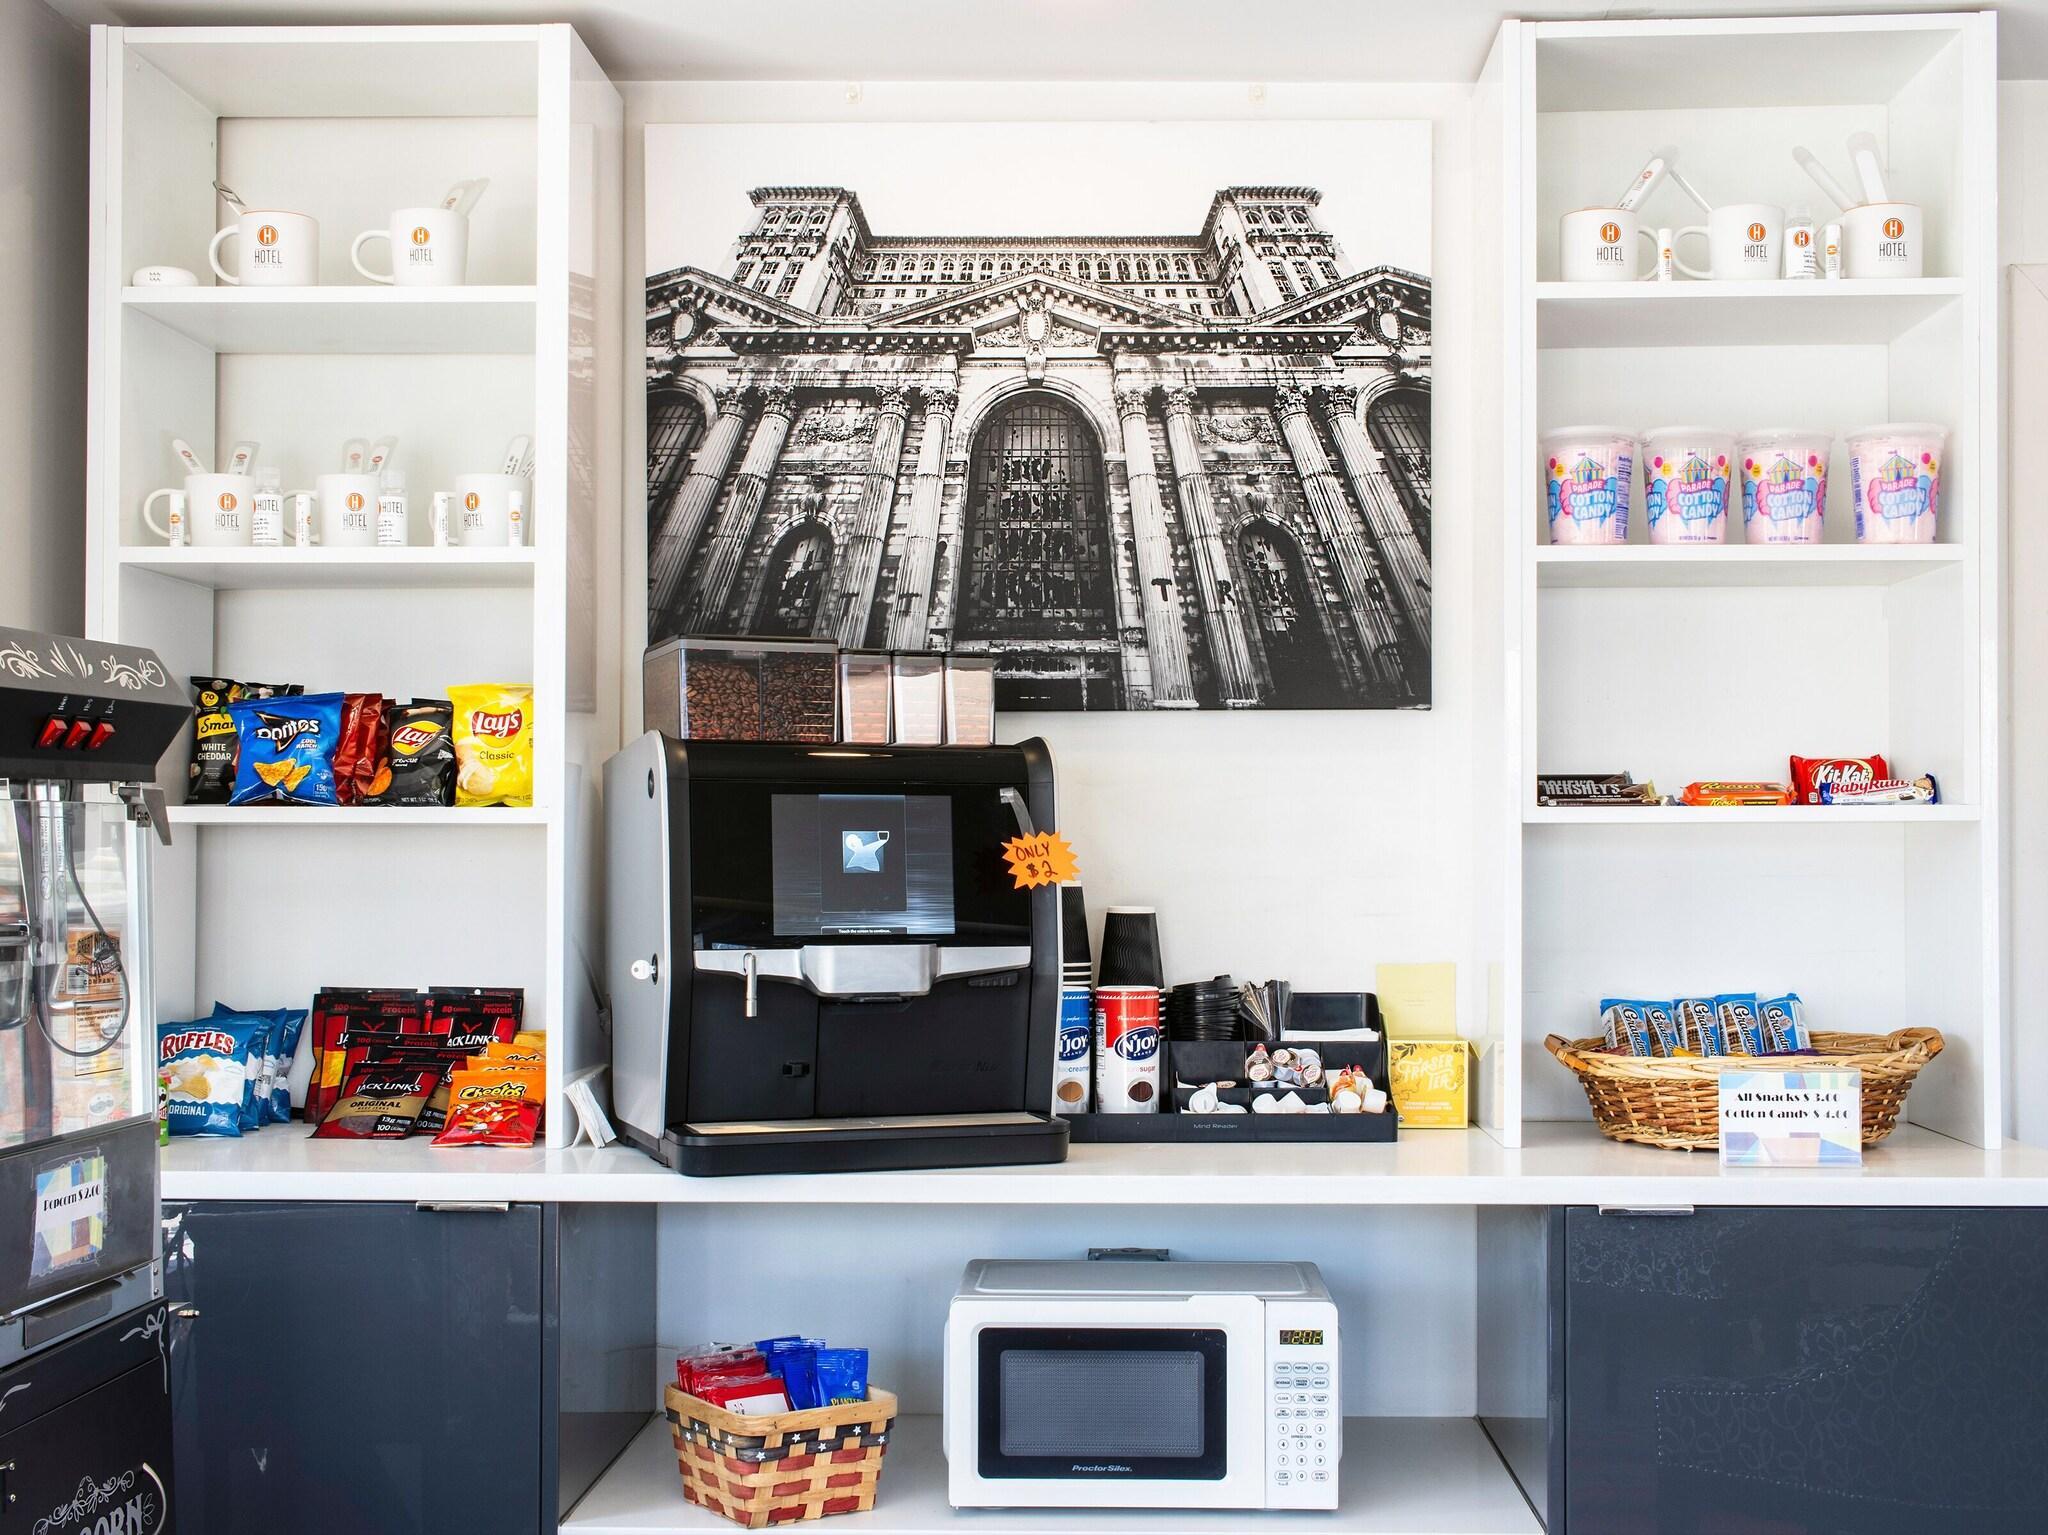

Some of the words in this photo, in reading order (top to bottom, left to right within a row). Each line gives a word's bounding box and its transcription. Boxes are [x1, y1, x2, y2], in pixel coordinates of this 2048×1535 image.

[410, 249, 432, 261] HOTEL
[1596, 247, 1623, 261] HOTEL
[1744, 245, 1768, 258] HOTEL
[1879, 243, 1907, 256] HOTEL
[255, 250, 283, 263] HOTEL
[1572, 481, 1603, 492] PARADE
[1681, 481, 1711, 492] PARADE
[1770, 482, 1801, 493] PARADE
[1883, 478, 1914, 490] PARADE
[1569, 492, 1615, 505] COTTON
[1678, 492, 1720, 505] COTTON
[1767, 491, 1812, 505] COTTON
[1879, 488, 1924, 503] COTTON
[257, 500, 279, 511] HOTEL
[382, 502, 403, 513] HOTEL
[1573, 504, 1611, 519] CANDY
[1683, 504, 1718, 519] CANDY
[1883, 502, 1922, 518] CANDY
[1771, 505, 1808, 519] CANDY
[215, 515, 239, 527] HOTEL
[343, 514, 367, 526] HOTEL
[464, 514, 483, 526] HOTEL
[204, 693, 214, 701] 70
[257, 720, 320, 740] Doritos
[476, 711, 520, 739] Lay's
[197, 753, 231, 761] CHEDDAR
[479, 751, 515, 760] Classic
[1545, 783, 1620, 795] HERSHEY'S
[1830, 782, 1868, 795] Baby
[1012, 841, 1050, 861] ONLY
[382, 1006, 417, 1014] Protein
[483, 1006, 513, 1014] Protein
[161, 1031, 235, 1061] RUFFLES
[447, 1036, 465, 1047] ACK
[354, 1083, 381, 1095] JACK
[460, 1082, 526, 1099] Cheetos
[1737, 1093, 1752, 1102] All
[1755, 1093, 1800, 1102] Snacks
[1815, 1093, 1838, 1102] 3.00
[350, 1100, 402, 1108] ORIGINAL
[169, 1105, 207, 1116] ORIGINAL
[1725, 1109, 1766, 1118] Cotton
[1769, 1109, 1808, 1118] Candy
[43, 1193, 77, 1211] Popcorn
